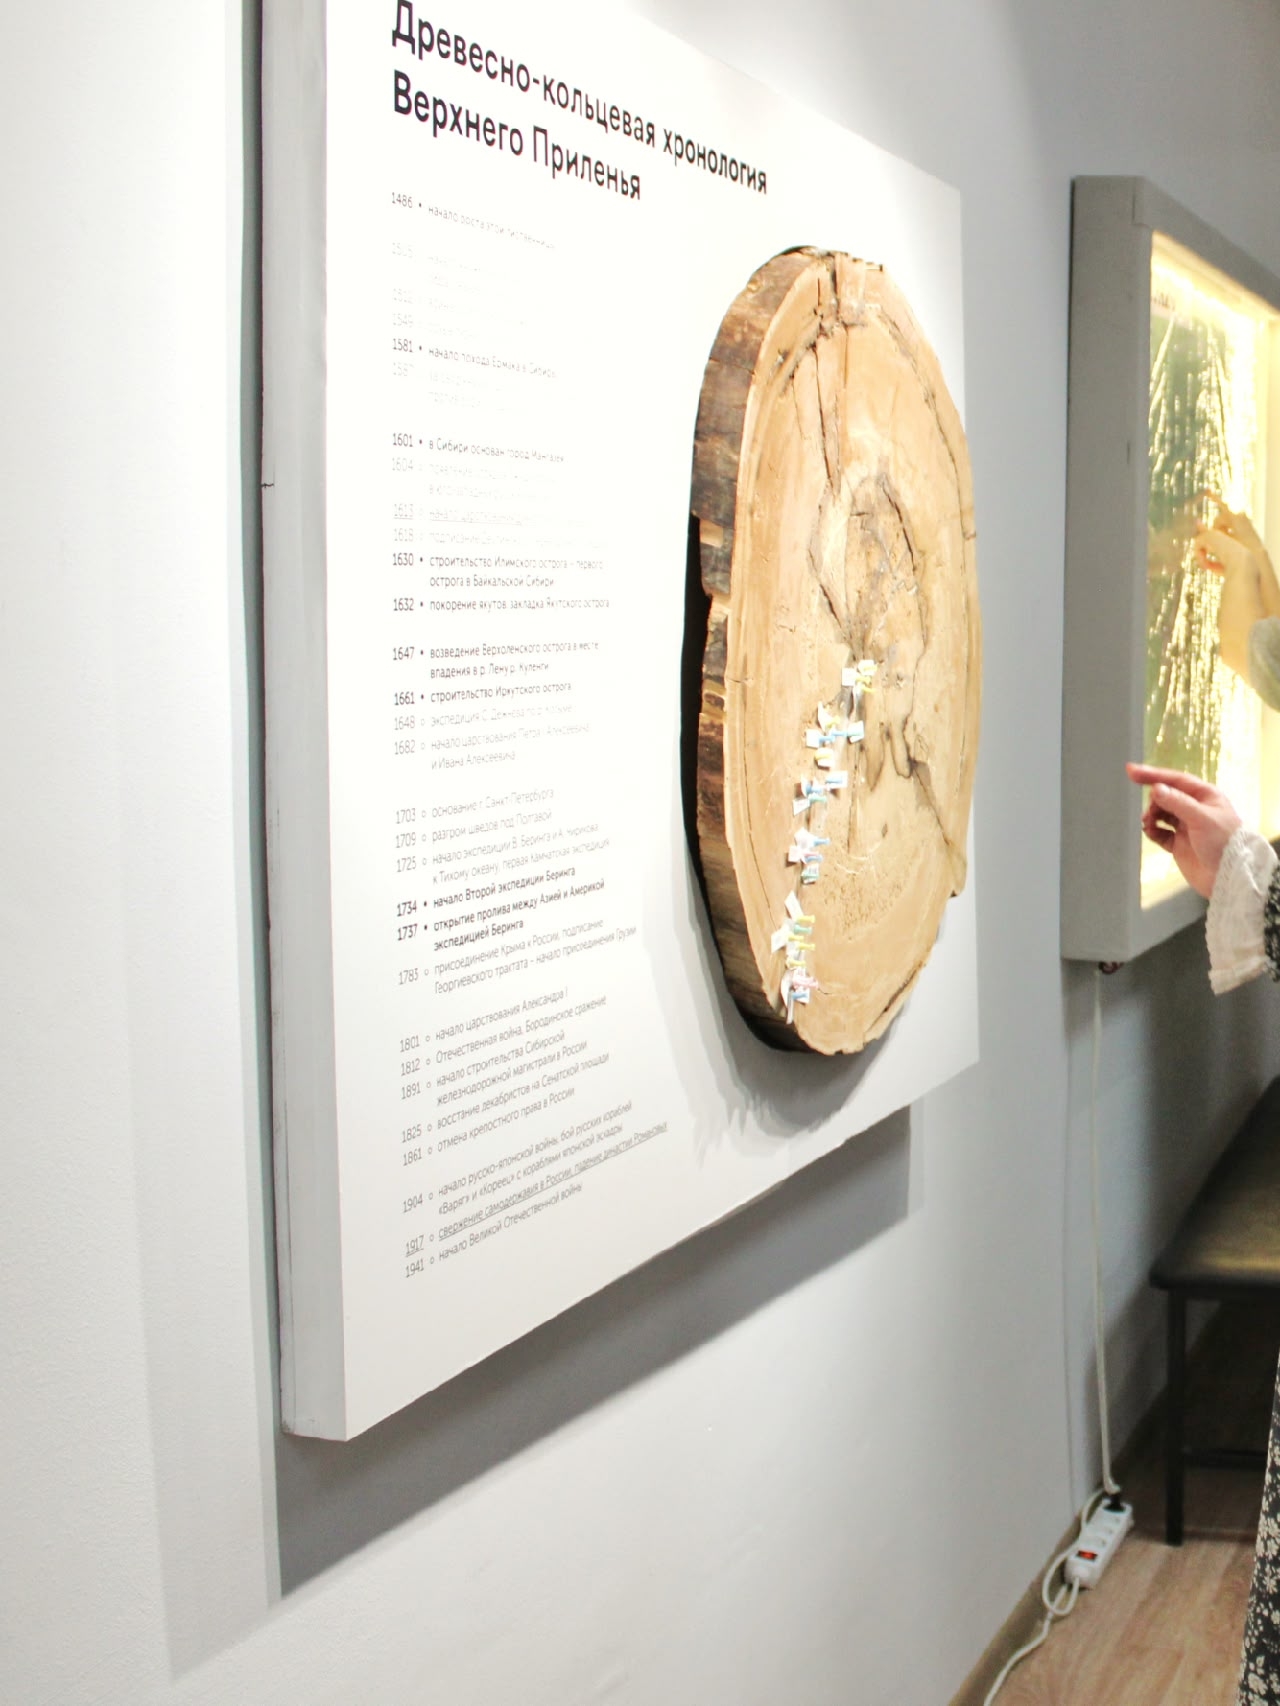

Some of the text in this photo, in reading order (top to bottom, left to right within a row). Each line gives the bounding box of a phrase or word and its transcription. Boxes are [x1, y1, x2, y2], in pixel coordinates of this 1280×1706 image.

[391, 0, 767, 195] Древесно-кольцевая хронология
[393, 70, 641, 201] Верхнего Приленья
[391, 192, 459, 222] 1486 начало
[392, 338, 413, 352] 1581
[428, 348, 459, 360] начало
[392, 433, 413, 447] 1601
[428, 440, 434, 449] в
[436, 438, 469, 453] Сибири
[470, 445, 505, 456] основан
[392, 553, 414, 566] 1630
[429, 557, 492, 567] строительство
[494, 556, 537, 568] Илимского
[539, 560, 568, 568] острога
[430, 574, 554, 587] острога в Байкальской Сибири
[393, 598, 414, 611] 1632
[430, 601, 477, 611] покорение
[509, 600, 544, 609] закладка
[546, 597, 581, 608] Якутского
[392, 646, 415, 660] 1647
[430, 647, 480, 658] возведение
[482, 643, 541, 656] Верхоленского
[542, 643, 572, 652] острога
[430, 667, 471, 678] впадения
[472, 666, 478, 675] в
[488, 663, 509, 674] Лену
[394, 683, 572, 705] 1661 строительство Иркутского острога
[394, 713, 480, 730] 1648 экспедиция
[394, 739, 416, 755] 1682
[431, 738, 461, 750] начало
[462, 732, 517, 747] царствования
[431, 761, 437, 770] и
[438, 758, 464, 768] Ивана
[395, 808, 416, 824] 1703
[431, 802, 477, 818] основание
[395, 832, 416, 848] 1709
[468, 821, 499, 834] шведов
[500, 818, 515, 828] под
[432, 851, 462, 864] начало
[463, 843, 511, 858] экспедиции
[521, 833, 552, 847] Беринга
[439, 870, 469, 882] Тихому
[502, 856, 529, 869] первая
[433, 893, 464, 907] начало
[465, 883, 496, 900] Второй
[498, 876, 544, 893] экспедиции
[546, 868, 576, 881] Беринга
[433, 914, 475, 931] открытие
[477, 904, 511, 921] пролива
[512, 899, 538, 910] между
[540, 889, 562, 903] Азией
[563, 891, 568, 899] и
[570, 880, 605, 896] Америкой
[434, 920, 524, 951] экспедицией Беринга
[434, 948, 499, 975] присоединение
[501, 941, 526, 957] Крыма
[562, 920, 604, 937] подписание
[434, 927, 637, 993] Георгиевского трактата начало присоединения Грузии
[400, 990, 565, 1052] 1801 начало царствования Александра
[401, 1058, 421, 1076] 1812
[436, 1035, 498, 1063] Отечественная
[525, 1008, 574, 1032] Бородинское
[575, 996, 607, 1016] сражение
[401, 1030, 565, 1099] 1891 начало строительства Сибирской
[437, 1040, 588, 1105] железнодорожной магистрали России
[402, 1125, 422, 1143] 1825
[437, 1105, 480, 1129] восстание
[482, 1085, 531, 1112] декабристов
[531, 1081, 540, 1089] на
[541, 1063, 579, 1087] Сенатской
[403, 1088, 575, 1166] 1861 отмена крепостного права России
[402, 1100, 632, 1213] 1904 начало русско-японской бой русских кораблей
[471, 1191, 477, 1200] и
[523, 1153, 561, 1176] кораблями
[563, 1136, 595, 1157] японской
[405, 1235, 424, 1254] 1917
[438, 1210, 484, 1238] свержение
[484, 1183, 539, 1216] самодержавия
[405, 1184, 582, 1278] 1941 начало Великой Отечественной войны
